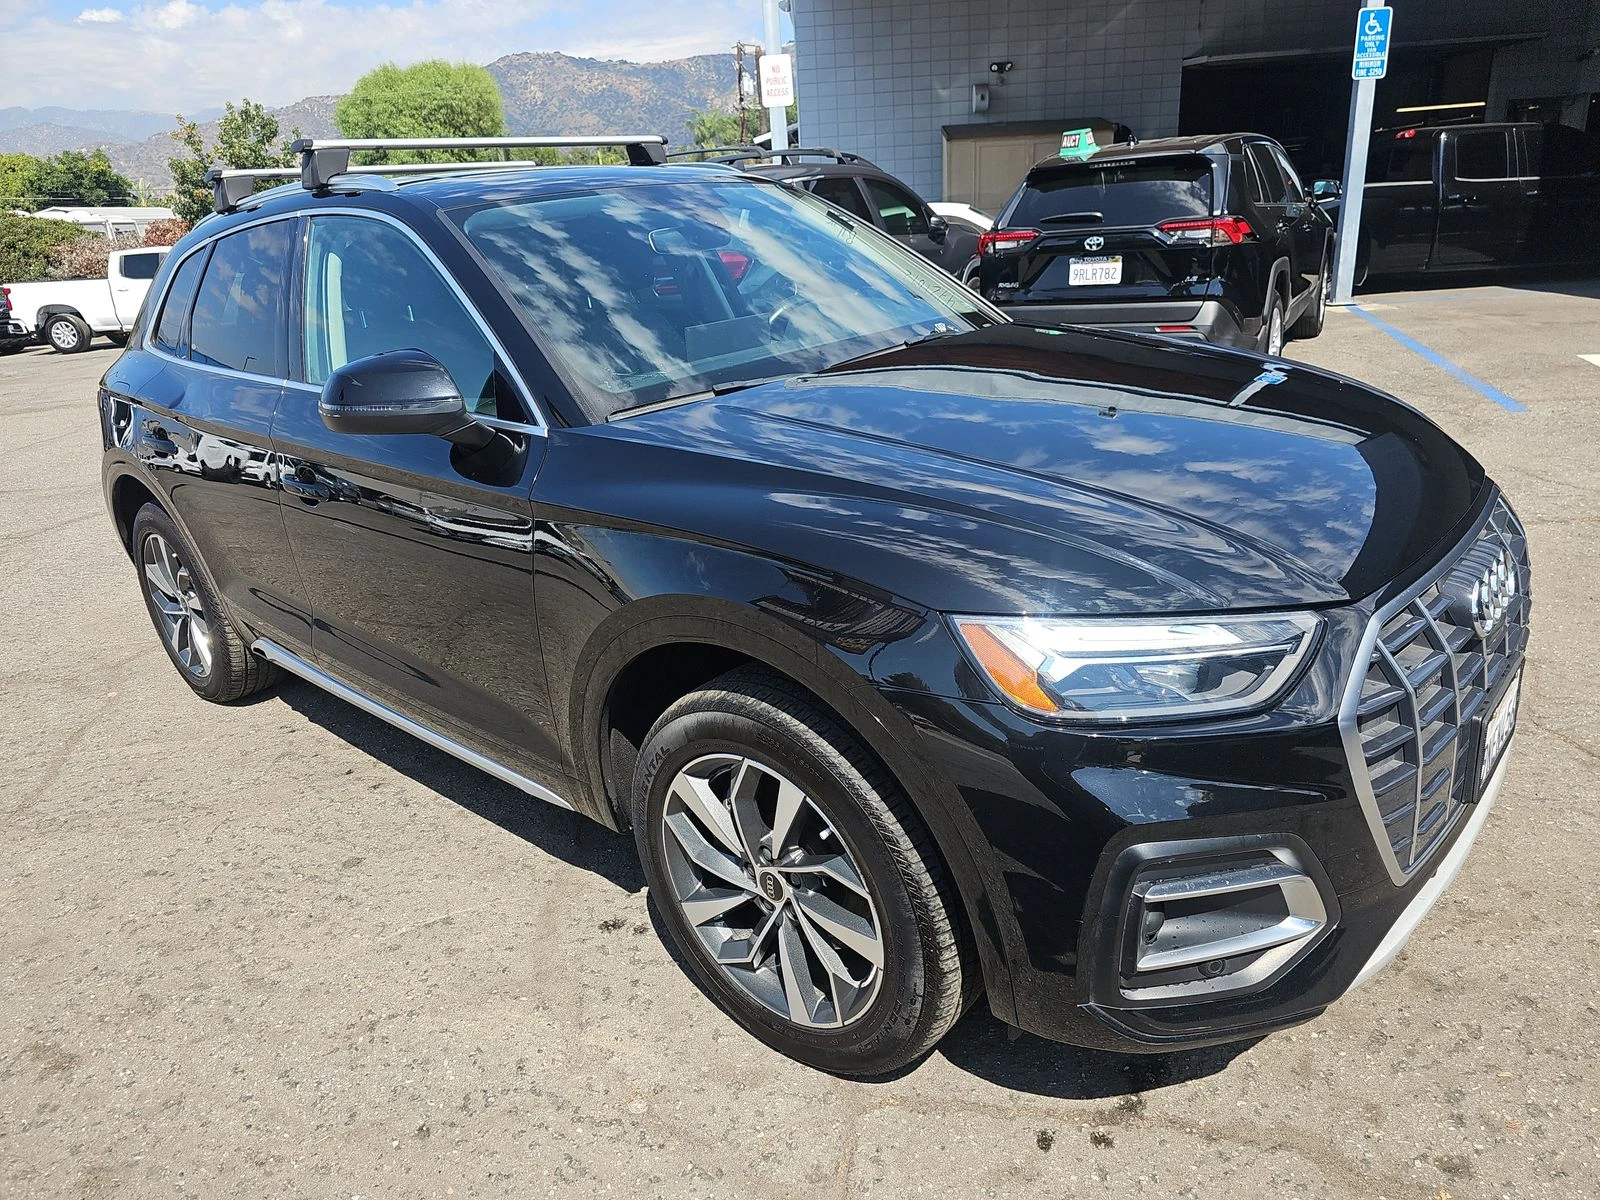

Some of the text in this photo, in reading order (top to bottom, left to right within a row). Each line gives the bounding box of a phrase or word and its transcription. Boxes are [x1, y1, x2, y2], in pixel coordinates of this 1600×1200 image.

[1361, 34, 1385, 42] PARKING
[771, 64, 780, 74] NO
[766, 76, 787, 85] PUBLIC
[767, 88, 789, 97] ACCESS
[1073, 267, 1117, 282] 9RLR782
